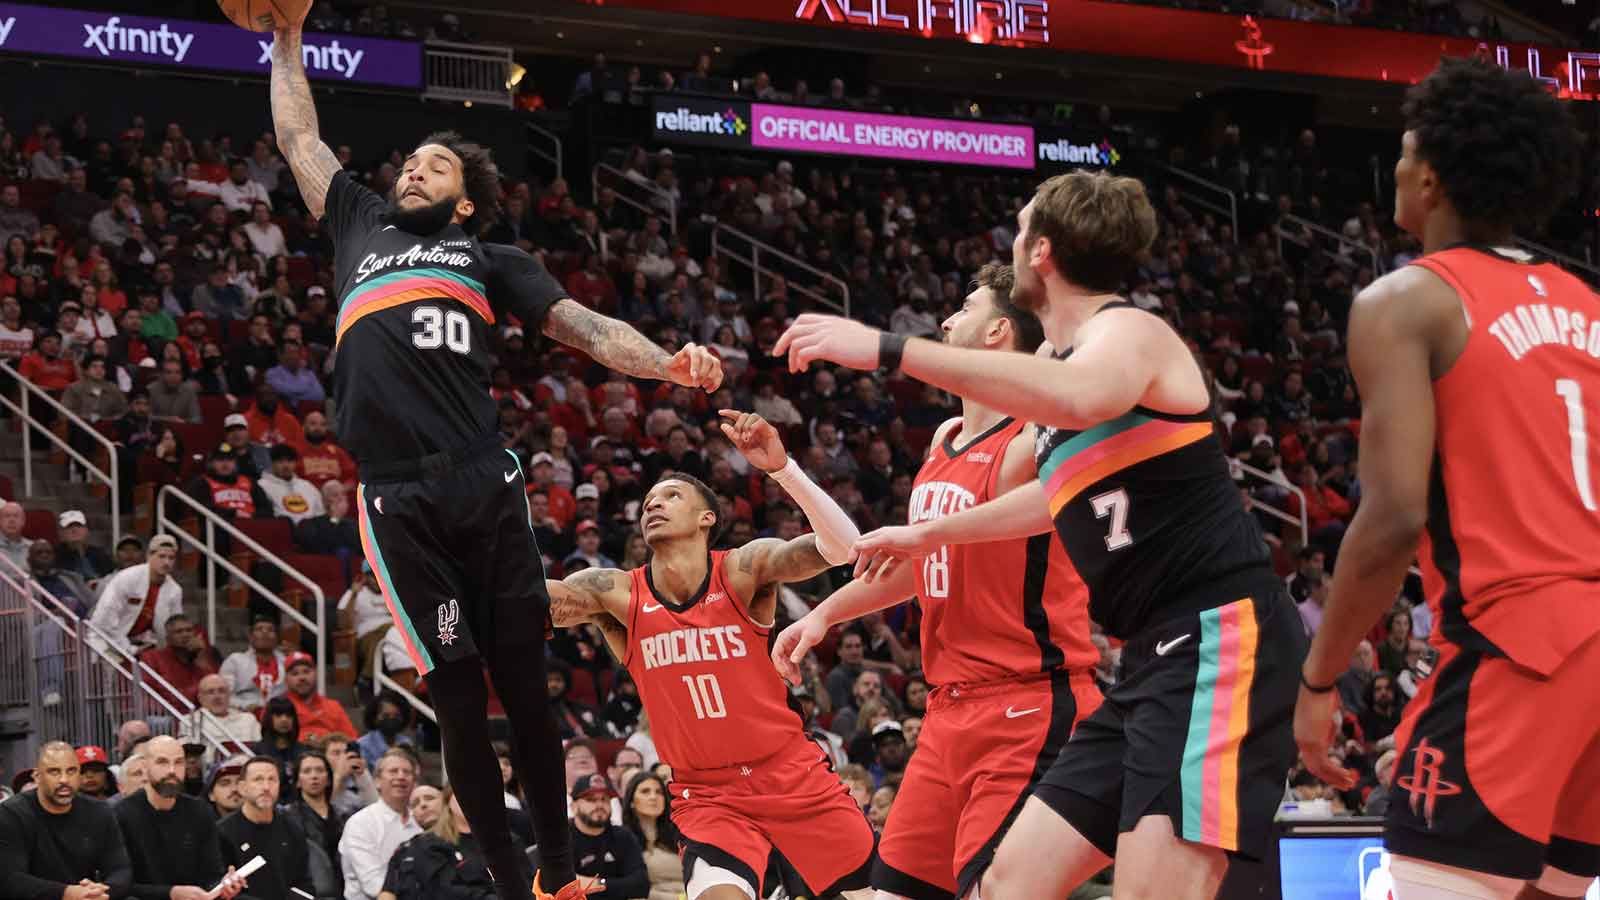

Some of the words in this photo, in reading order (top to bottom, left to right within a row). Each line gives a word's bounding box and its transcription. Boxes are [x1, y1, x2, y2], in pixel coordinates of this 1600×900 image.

[84, 17, 194, 62] xfinity
[258, 40, 363, 78] xnity
[656, 108, 724, 134] reliant
[760, 115, 850, 144] OFFICIAL
[855, 124, 930, 149] ENERGY
[933, 130, 1026, 157] PROVIDER
[1038, 139, 1100, 165] reliant
[355, 253, 394, 283] San
[396, 244, 473, 268] Antonio
[411, 306, 472, 355] 30
[1555, 379, 1597, 511] 1
[908, 481, 976, 525] OCKETS
[1089, 487, 1134, 552] 7
[640, 625, 748, 670] ROCKETS
[681, 673, 727, 719] 10
